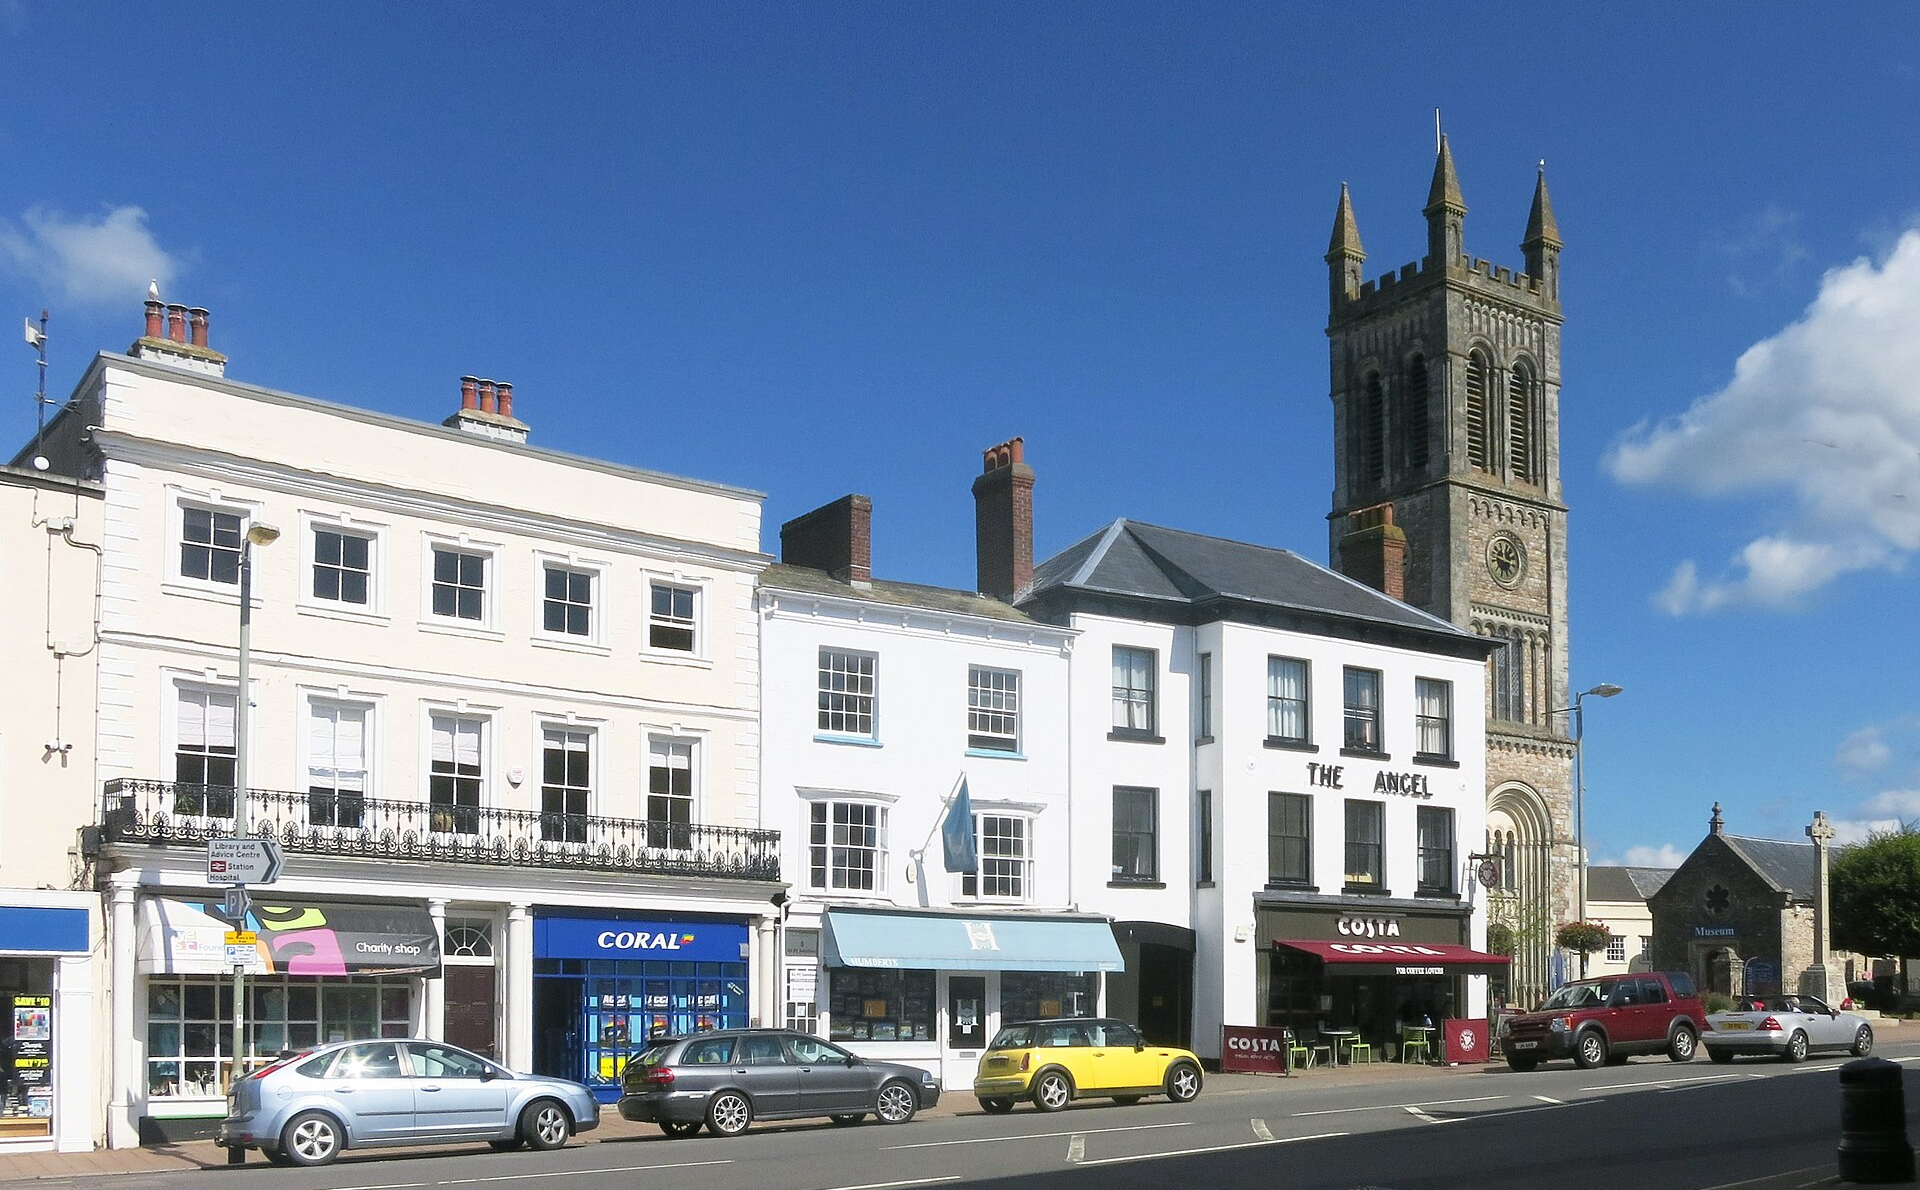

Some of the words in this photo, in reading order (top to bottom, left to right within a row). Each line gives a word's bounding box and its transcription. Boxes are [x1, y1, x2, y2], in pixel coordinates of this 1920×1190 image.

[1306, 762, 1344, 789] THE
[1373, 770, 1433, 799] ANGEL
[215, 842, 239, 851] Library
[1338, 917, 1400, 939] COSTA
[1695, 926, 1734, 936] Museum
[597, 931, 680, 950] CORAL
[355, 942, 392, 955] Charity
[394, 943, 421, 956] shop
[1406, 967, 1425, 975] COFFEE
[1425, 967, 1444, 975] LOVERS
[14, 996, 36, 1006] SAVE
[1228, 1037, 1280, 1052] COSTA
[15, 1058, 34, 1067] ONLY
